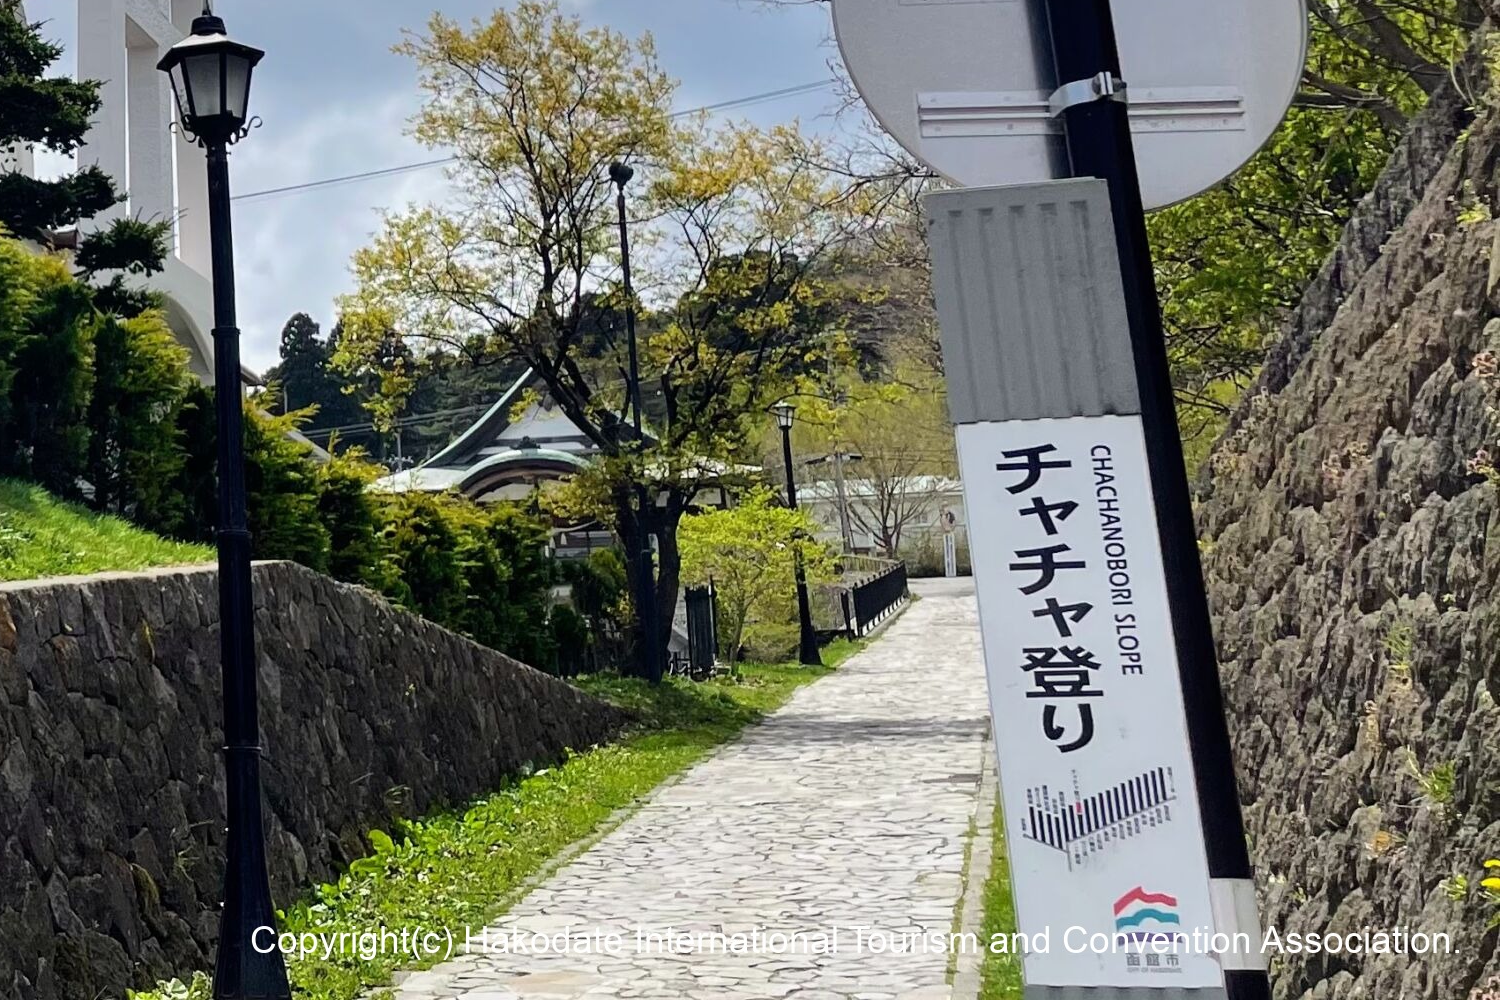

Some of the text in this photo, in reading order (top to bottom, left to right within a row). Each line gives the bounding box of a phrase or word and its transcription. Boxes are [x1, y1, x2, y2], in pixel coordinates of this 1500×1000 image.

[995, 443, 1105, 755] チャチャ登り
[1090, 444, 1143, 677] CHACHANOBORI SLOPE
